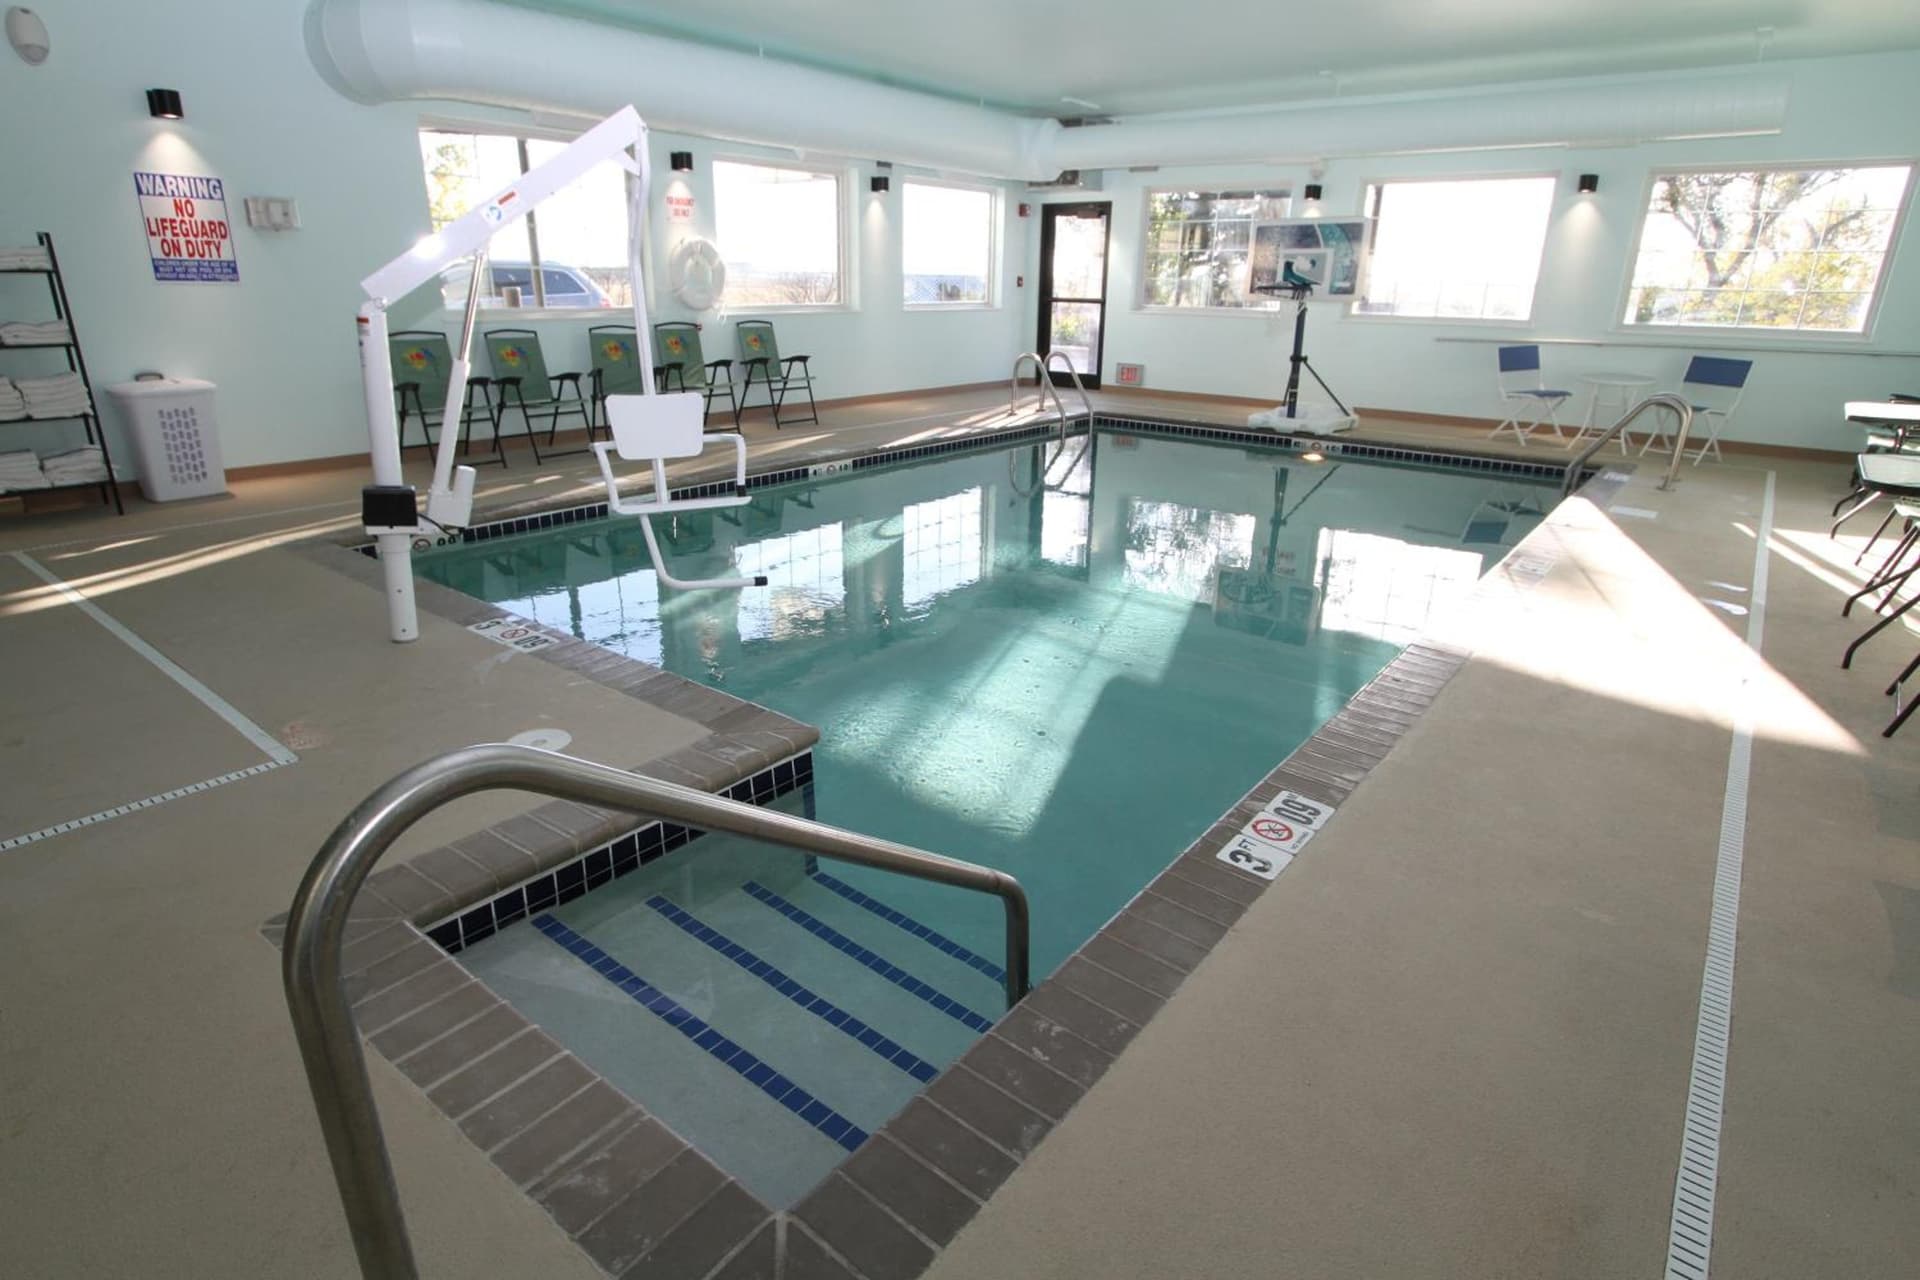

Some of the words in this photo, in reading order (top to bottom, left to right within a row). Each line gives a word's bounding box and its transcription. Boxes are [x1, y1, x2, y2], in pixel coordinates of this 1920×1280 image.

[136, 174, 221, 199] WARNING
[174, 198, 195, 218] NO
[146, 218, 228, 240] LIFEGUARD
[160, 240, 182, 258] ON
[185, 240, 222, 259] DUTY
[1238, 838, 1256, 852] FT
[1229, 849, 1272, 873] 3
